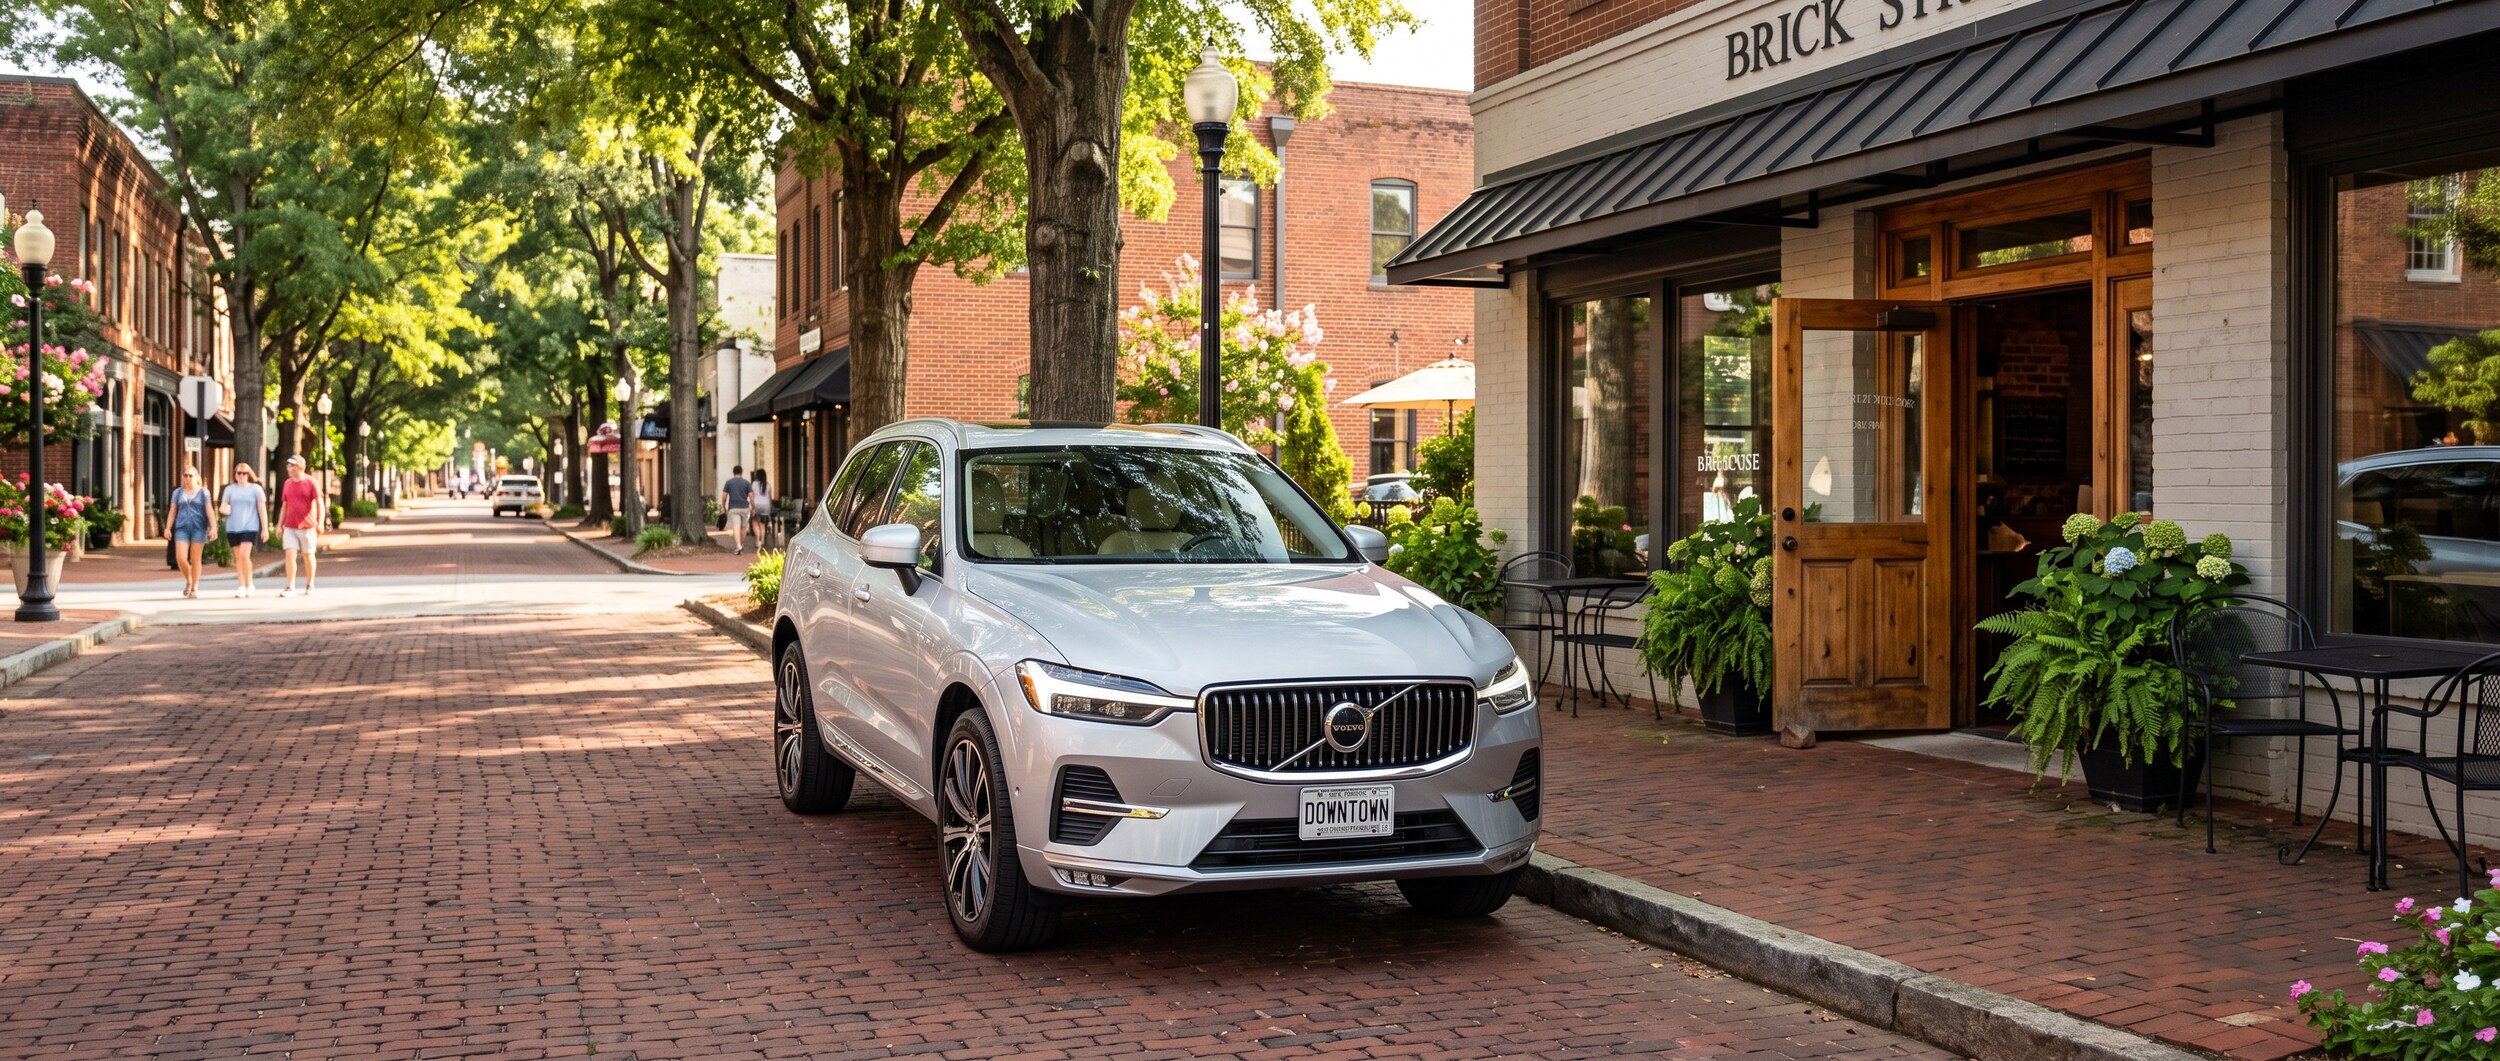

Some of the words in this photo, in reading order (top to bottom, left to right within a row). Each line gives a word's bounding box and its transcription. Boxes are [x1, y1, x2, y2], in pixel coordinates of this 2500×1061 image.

[1725, 0, 1855, 80] BRICK
[1332, 724, 1364, 732] VOLVO
[1305, 798, 1389, 825] DOWNTOWN
